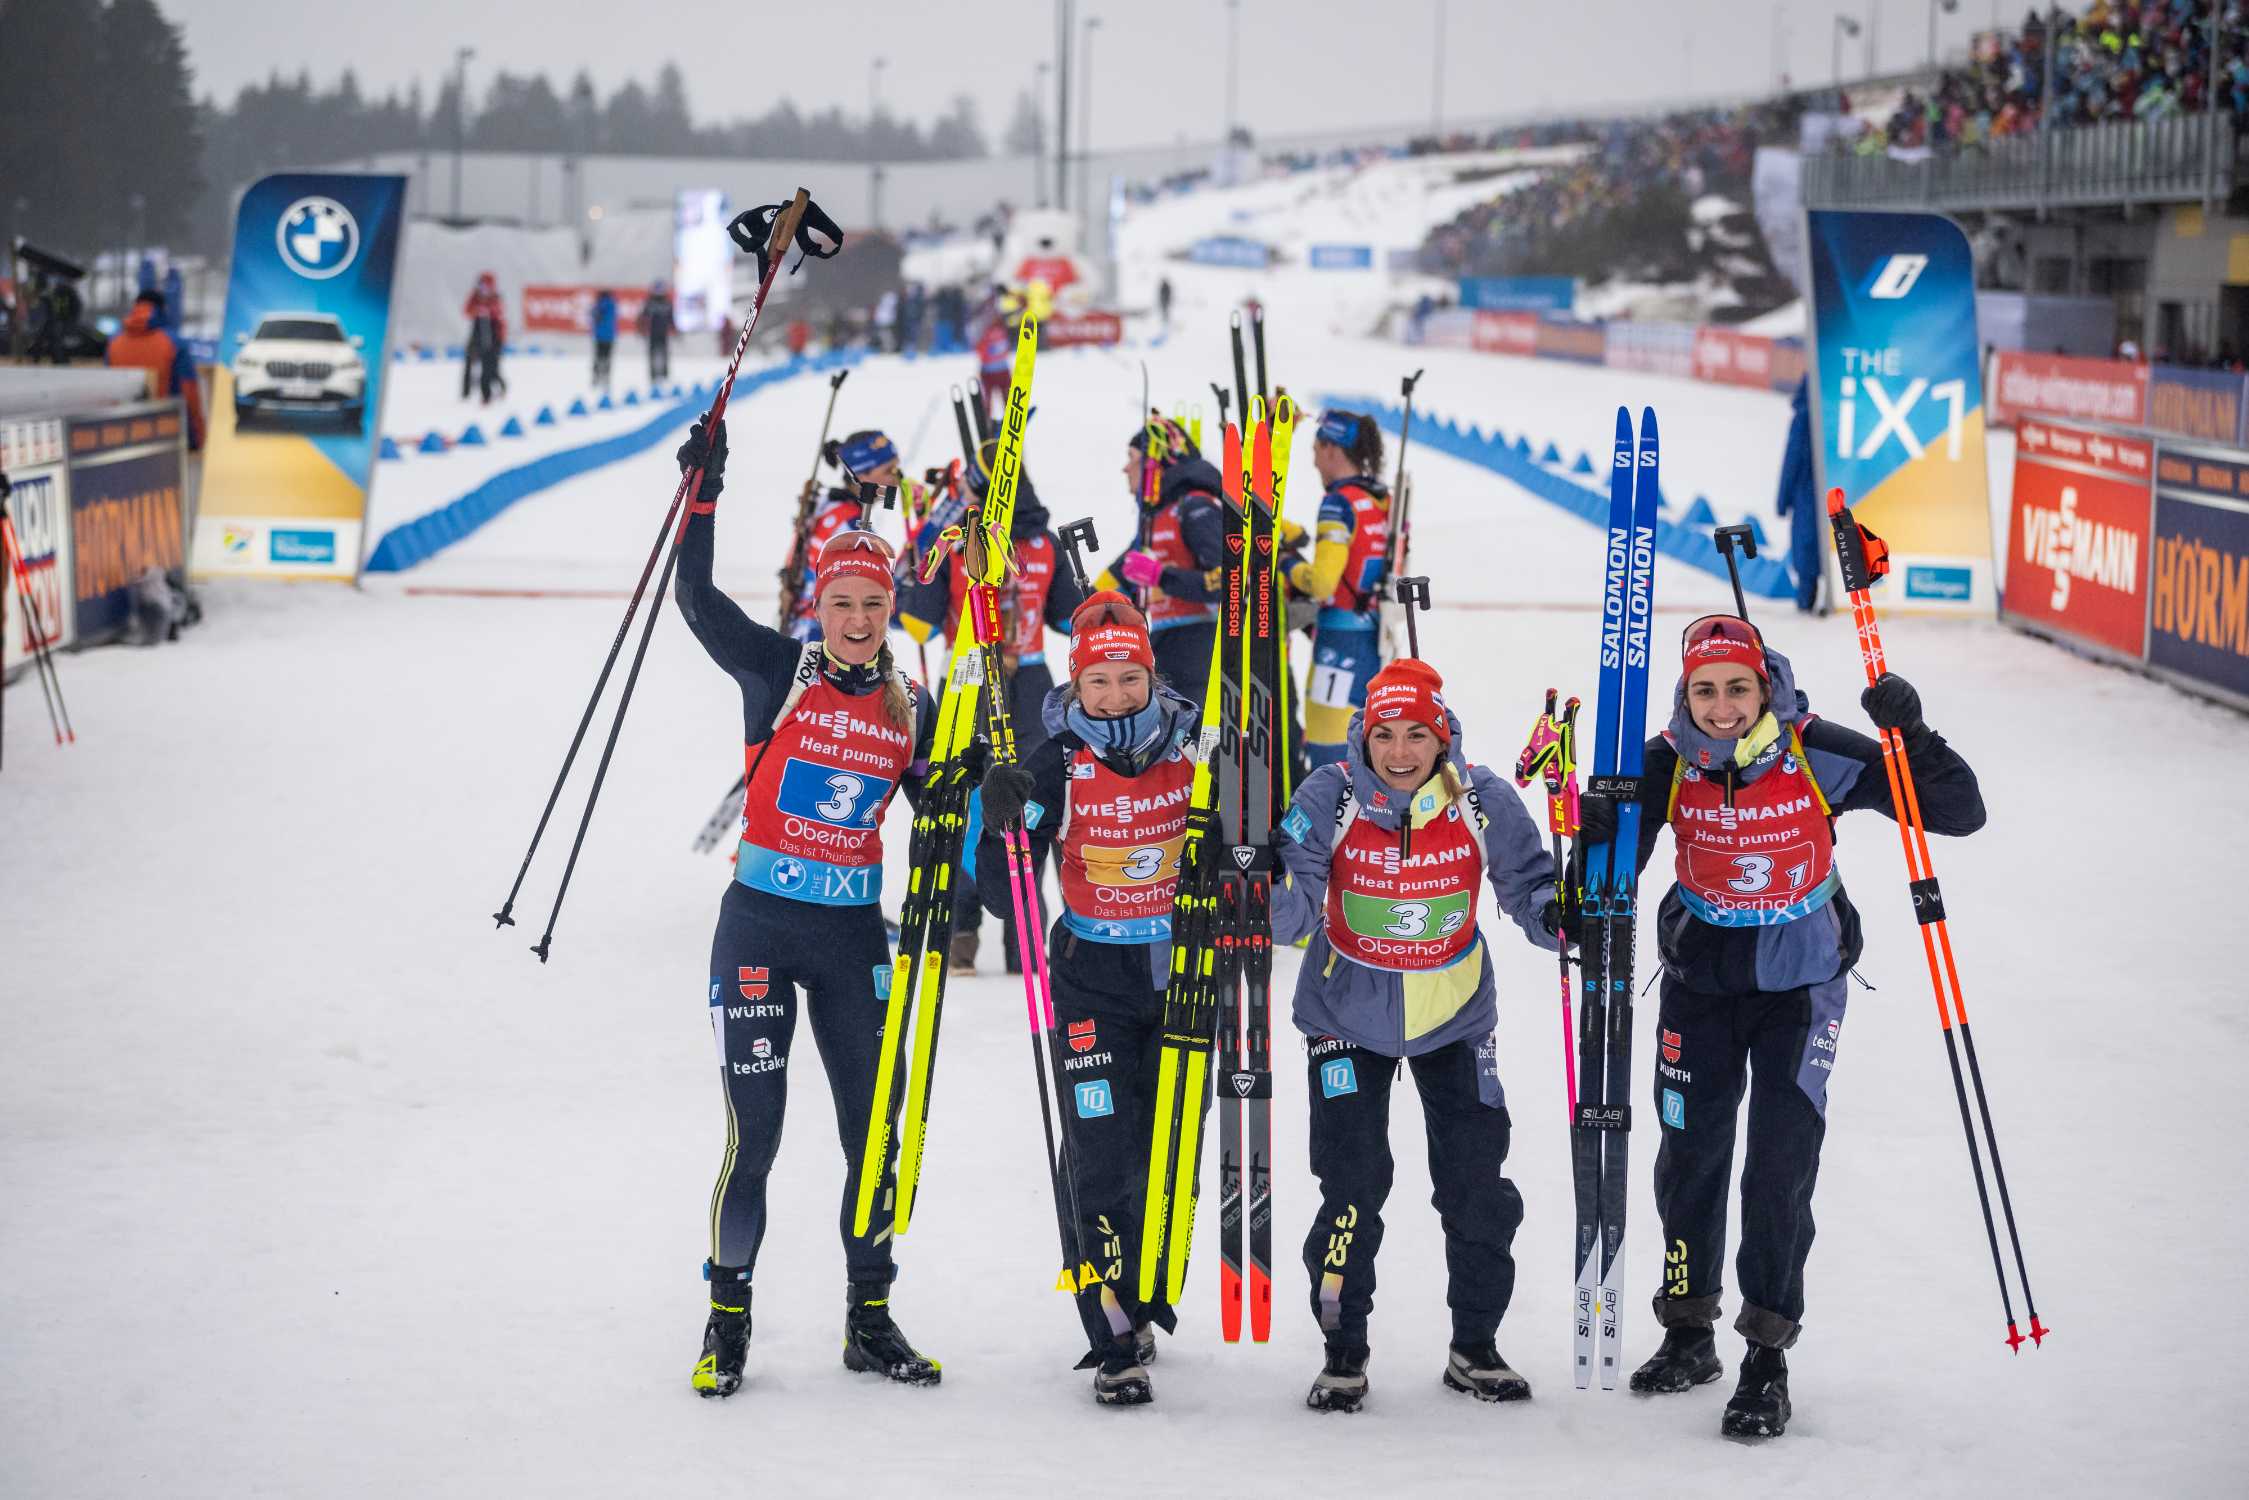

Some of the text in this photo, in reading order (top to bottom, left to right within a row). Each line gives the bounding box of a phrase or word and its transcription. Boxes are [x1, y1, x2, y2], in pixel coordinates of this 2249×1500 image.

[1841, 347, 1902, 376] THE
[1837, 376, 1966, 461] iX1
[992, 385, 1028, 525] FISCHER
[1836, 532, 1856, 590] ONE WAY
[986, 590, 999, 637] LEKI
[1229, 565, 1241, 637] ROSSIGNOL
[1258, 566, 1270, 638] ROSSIGNOL
[1602, 527, 1628, 669] SALOMON
[1628, 526, 1653, 669] SALOMON
[796, 649, 820, 687] JOKA
[1328, 672, 1336, 702] 1
[796, 710, 908, 748] VIESSMANN
[800, 735, 894, 769] Heat pumps
[815, 773, 865, 821] 3
[1680, 795, 1811, 830] VIESSMANN
[784, 818, 868, 849] Oberhof
[1090, 815, 1188, 840] Heat pumps
[1694, 827, 1800, 847] Heat pumps
[779, 839, 801, 854] Das
[803, 846, 817, 857] ist
[1120, 847, 1165, 880] 3
[1344, 844, 1471, 875] VIESSMANN
[811, 867, 870, 898] THE iX1
[1353, 873, 1460, 893] Heat pumps
[1727, 854, 1808, 893] 3 1
[1094, 905, 1117, 916] Das
[1119, 905, 1134, 917] ist
[1704, 891, 1801, 910] Oberhof
[1384, 903, 1466, 938] 3 2
[1357, 937, 1452, 956] Oberhof
[727, 1004, 784, 1020] WÜRTH
[1163, 1033, 1210, 1045] FISCHER
[733, 1056, 785, 1076] tectake
[1064, 1051, 1112, 1071] WÜRTH
[1324, 1204, 1358, 1268] GER
[1665, 1239, 1689, 1296] GER
